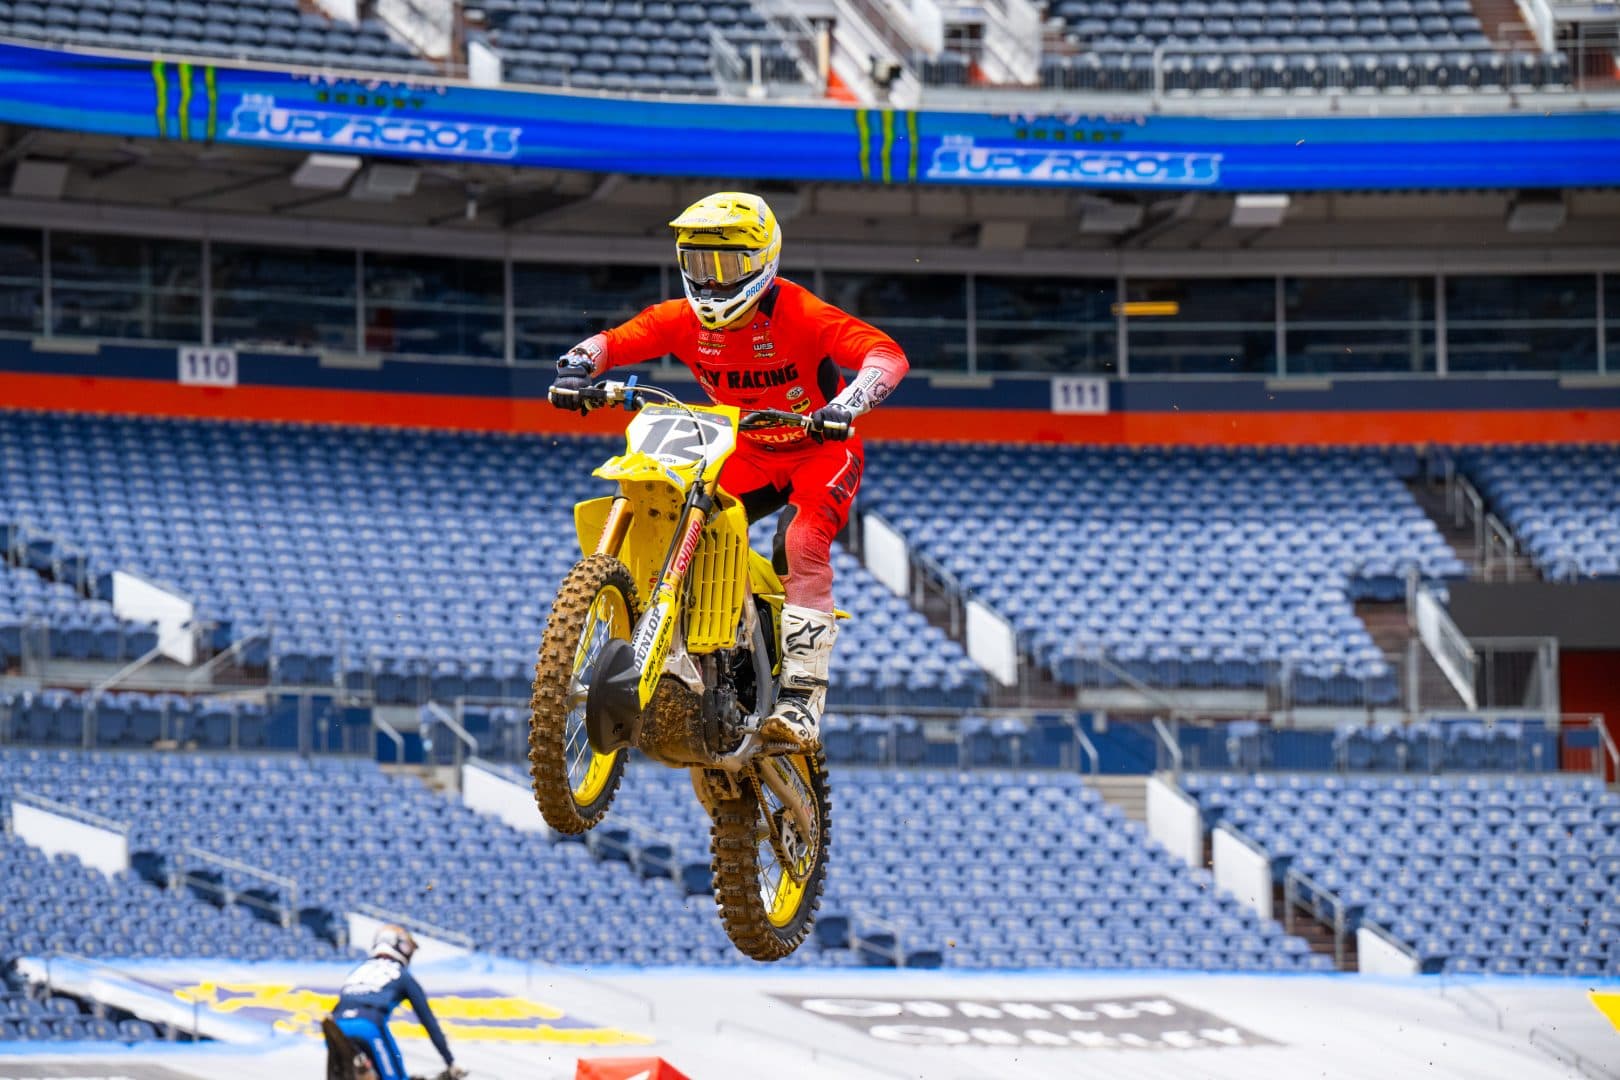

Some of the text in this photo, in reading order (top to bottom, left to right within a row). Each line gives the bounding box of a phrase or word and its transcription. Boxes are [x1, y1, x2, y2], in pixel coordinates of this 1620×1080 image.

[187, 353, 231, 379] 110
[727, 362, 799, 389] RACING
[1061, 383, 1101, 407] 111
[637, 418, 720, 462] 12
[677, 520, 702, 574] SHOWA
[634, 606, 663, 672] DUNLOP
